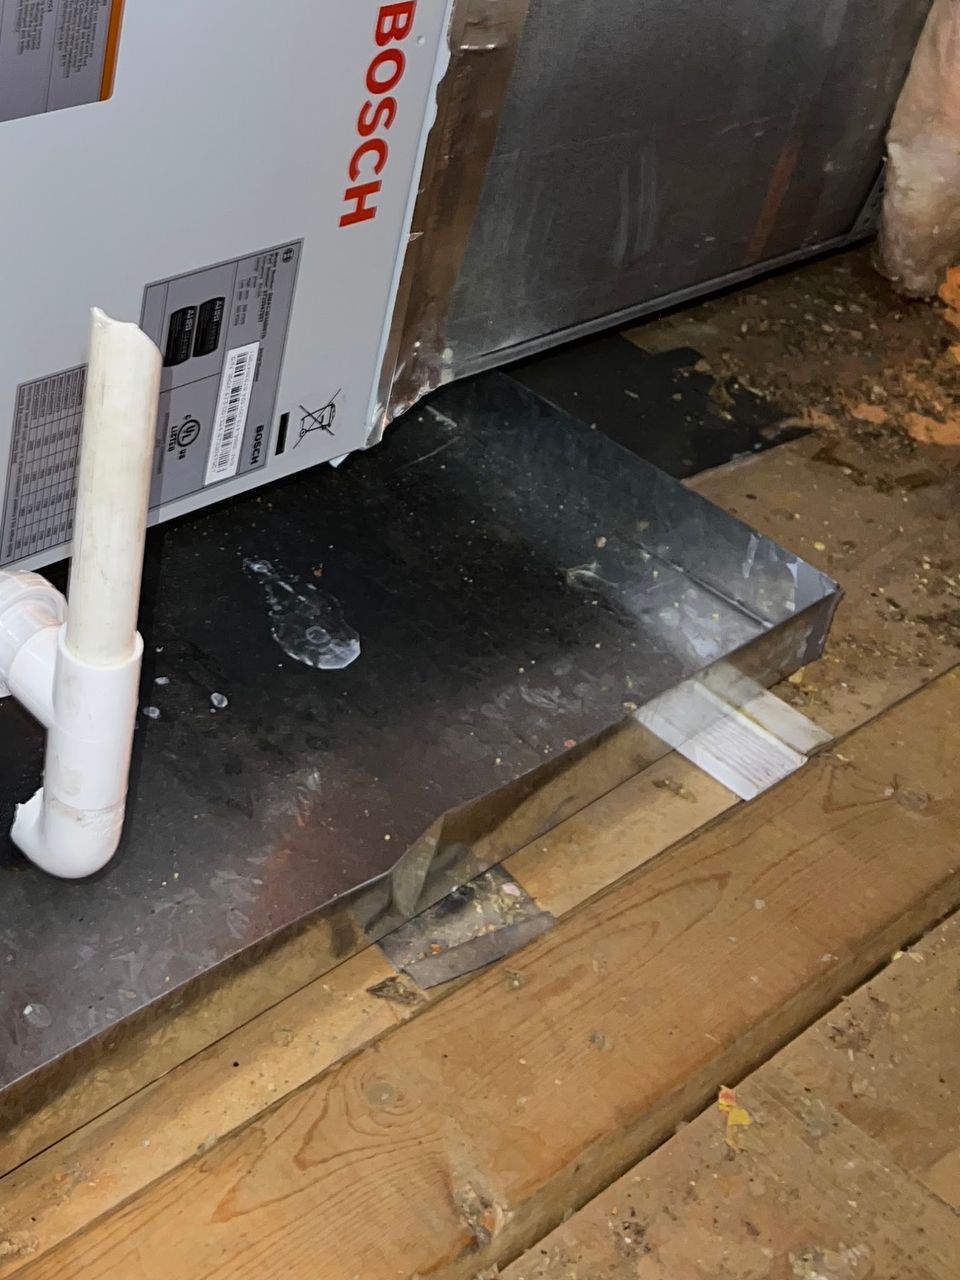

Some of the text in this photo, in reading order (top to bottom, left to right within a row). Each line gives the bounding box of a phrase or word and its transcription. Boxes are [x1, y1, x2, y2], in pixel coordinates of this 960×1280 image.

[339, 0, 417, 227] BOSCH
[168, 425, 177, 452] LISTED
[250, 424, 264, 465] BOSCH
